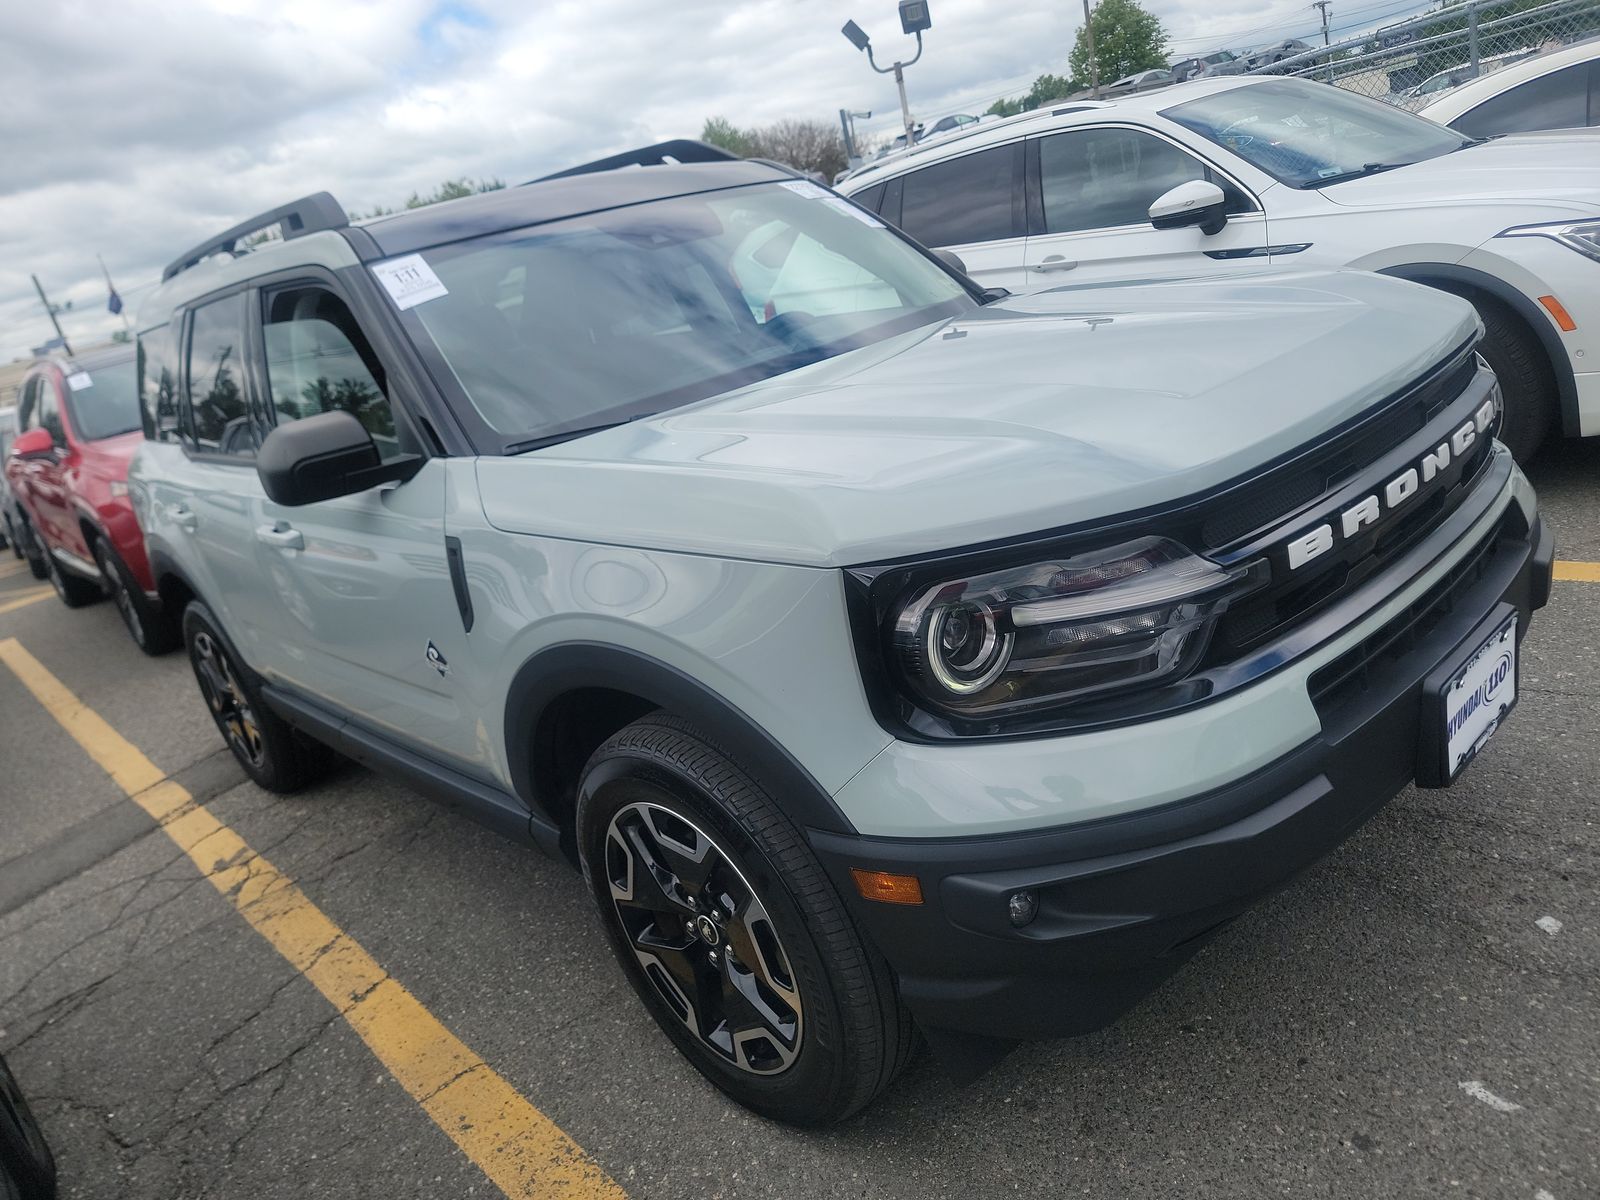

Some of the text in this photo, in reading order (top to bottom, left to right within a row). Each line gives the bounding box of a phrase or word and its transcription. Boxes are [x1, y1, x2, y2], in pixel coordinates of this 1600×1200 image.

[1287, 400, 1494, 570] BRONCO
[1447, 659, 1507, 743] HYUNDAI 110
